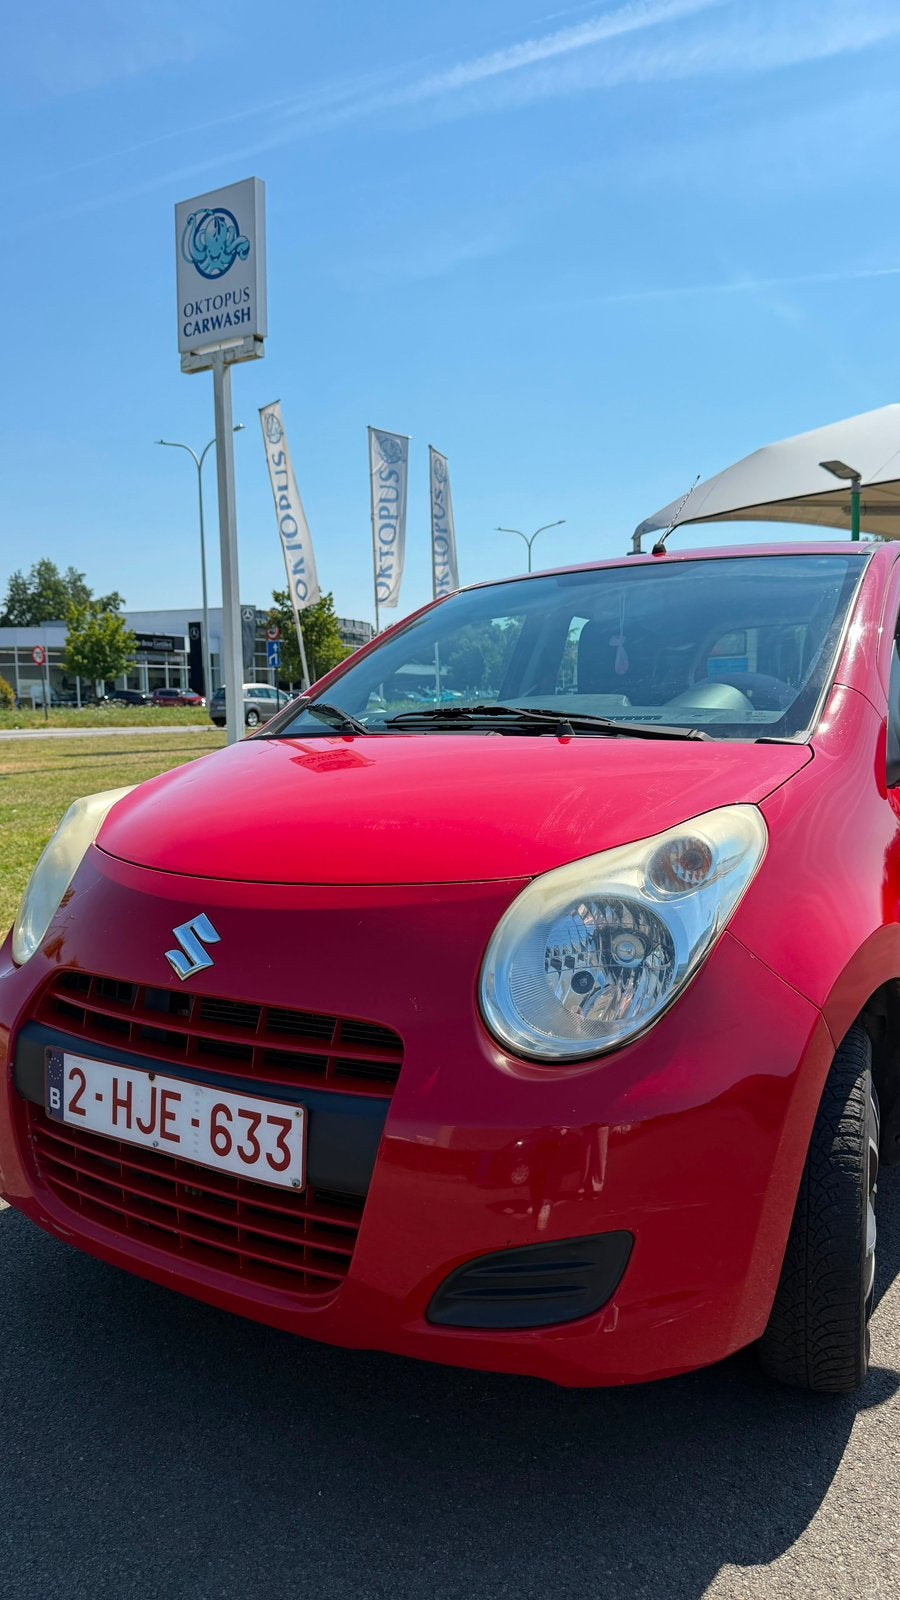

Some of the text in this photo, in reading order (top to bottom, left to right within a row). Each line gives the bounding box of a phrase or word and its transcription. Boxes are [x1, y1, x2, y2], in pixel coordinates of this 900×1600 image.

[183, 286, 250, 319] OKTOPUS
[183, 306, 251, 338] CARWASH
[376, 469, 401, 603] OKTOPUS
[50, 1087, 61, 1110] B
[68, 1067, 293, 1172] 2-HJE-633
